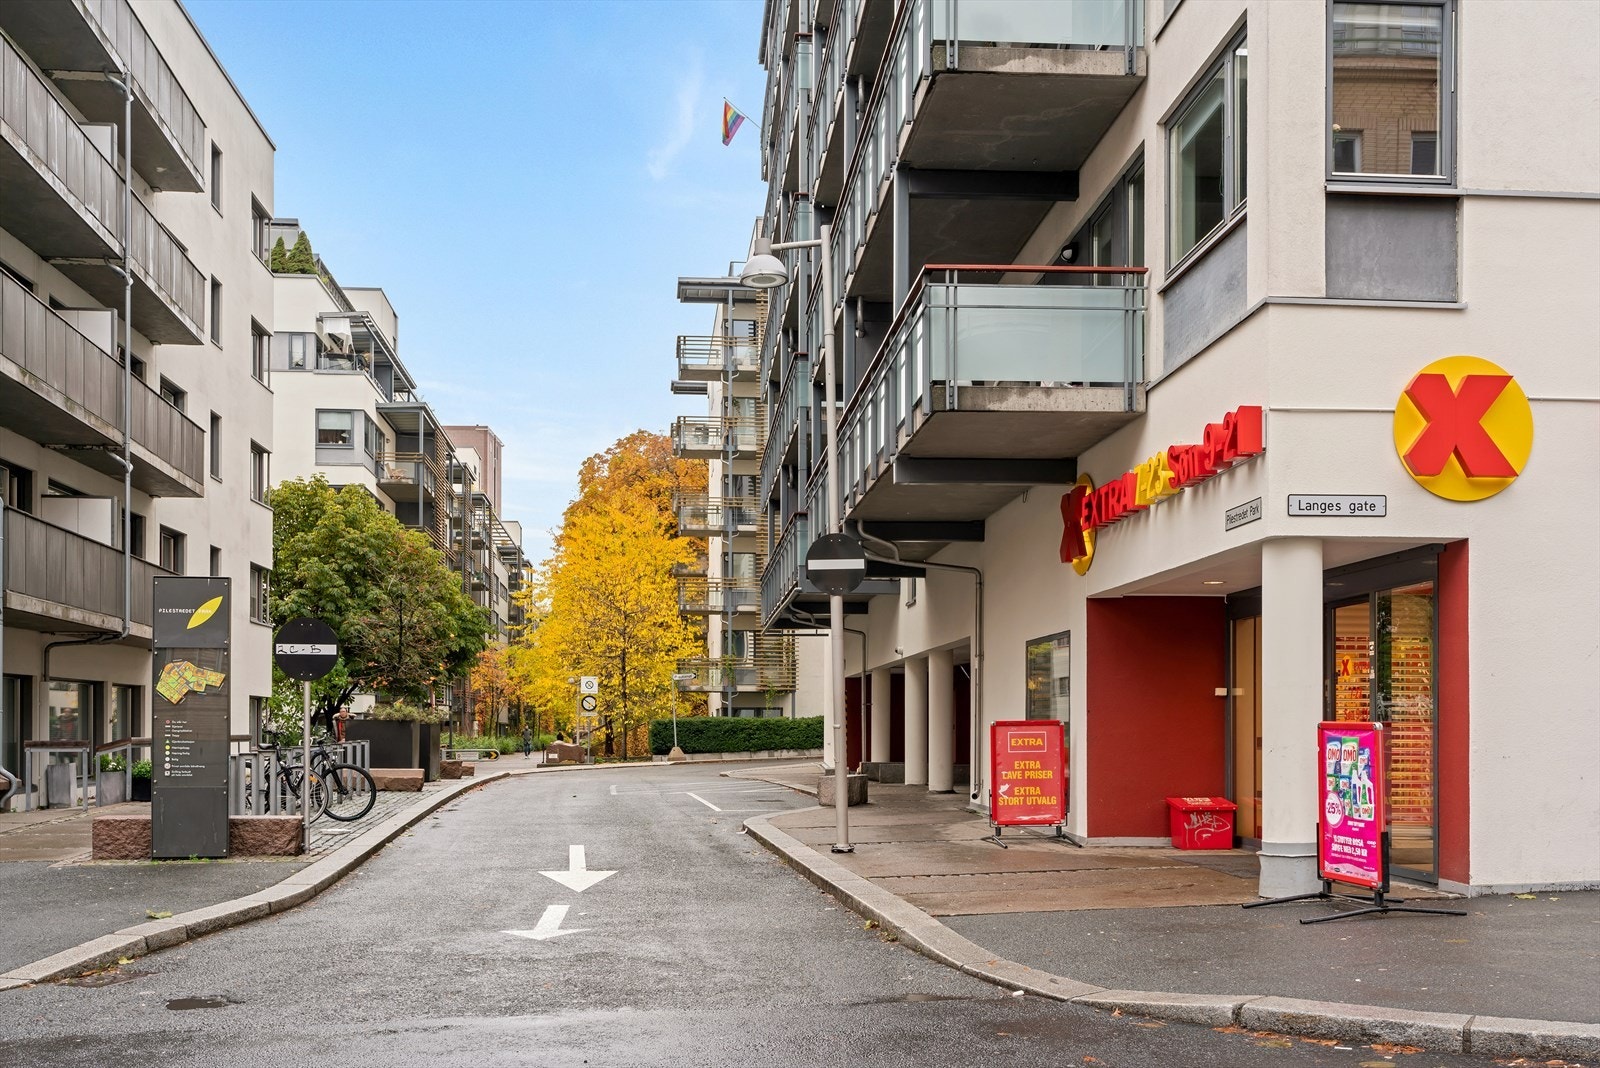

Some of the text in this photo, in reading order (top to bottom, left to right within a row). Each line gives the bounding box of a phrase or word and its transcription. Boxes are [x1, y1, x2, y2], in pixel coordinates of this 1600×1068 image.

[1404, 373, 1519, 478] X
[1081, 473, 1145, 532] EXTRA
[1168, 445, 1218, 489] Søn
[1204, 405, 1263, 470] 9-21
[1249, 503, 1260, 516] Park
[1298, 499, 1376, 514] Langes gate
[1011, 738, 1043, 746] EXTRA
[1014, 761, 1041, 769] EXTRA
[1002, 770, 1053, 779] LAVE PRISER
[1014, 787, 1041, 795] EXTRA
[998, 796, 1057, 806] STORT UTVALG
